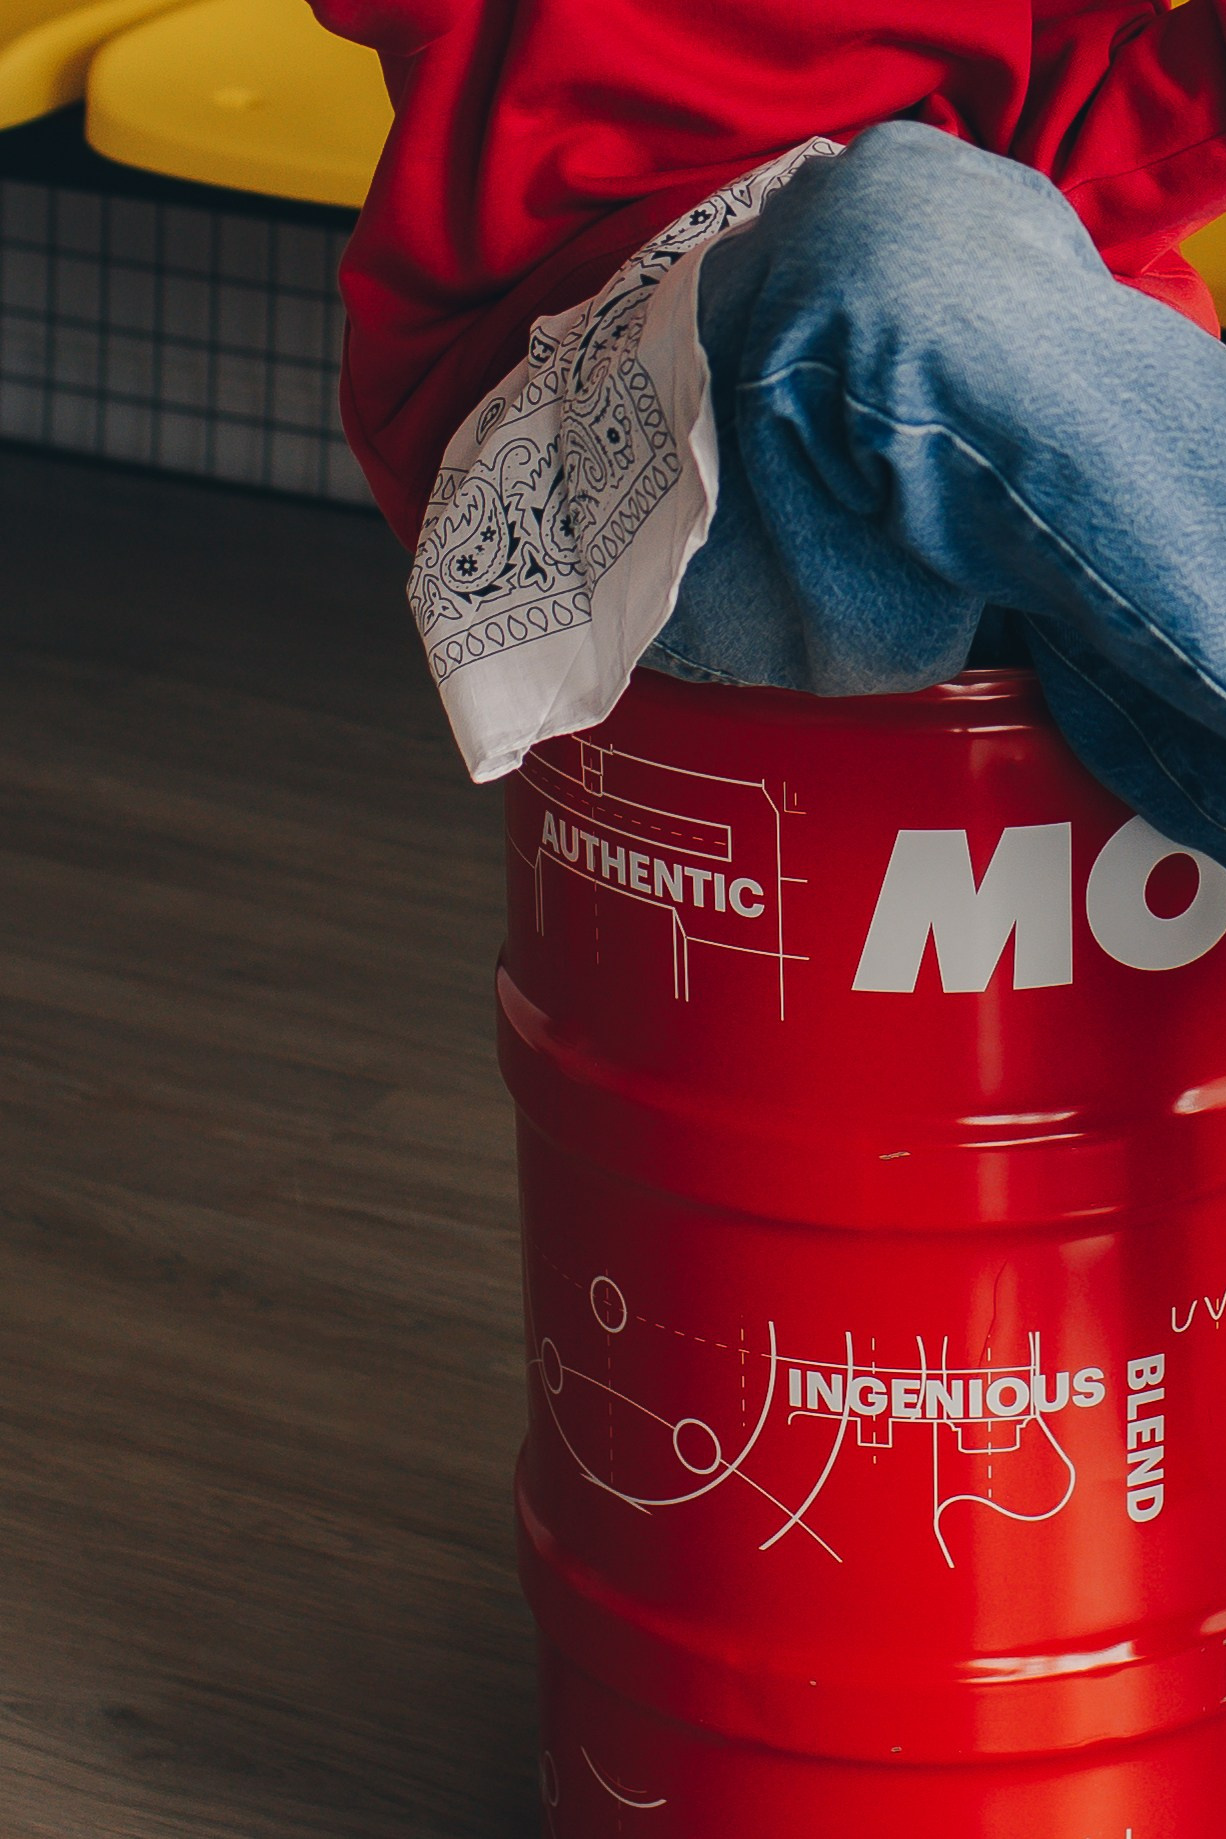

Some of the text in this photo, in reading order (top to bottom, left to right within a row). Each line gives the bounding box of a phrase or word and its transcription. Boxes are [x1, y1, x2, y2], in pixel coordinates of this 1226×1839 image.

[542, 810, 765, 918] AUTHENTIC
[788, 1367, 1106, 1419] INGENIOUS
[1126, 1353, 1165, 1523] BLEND
